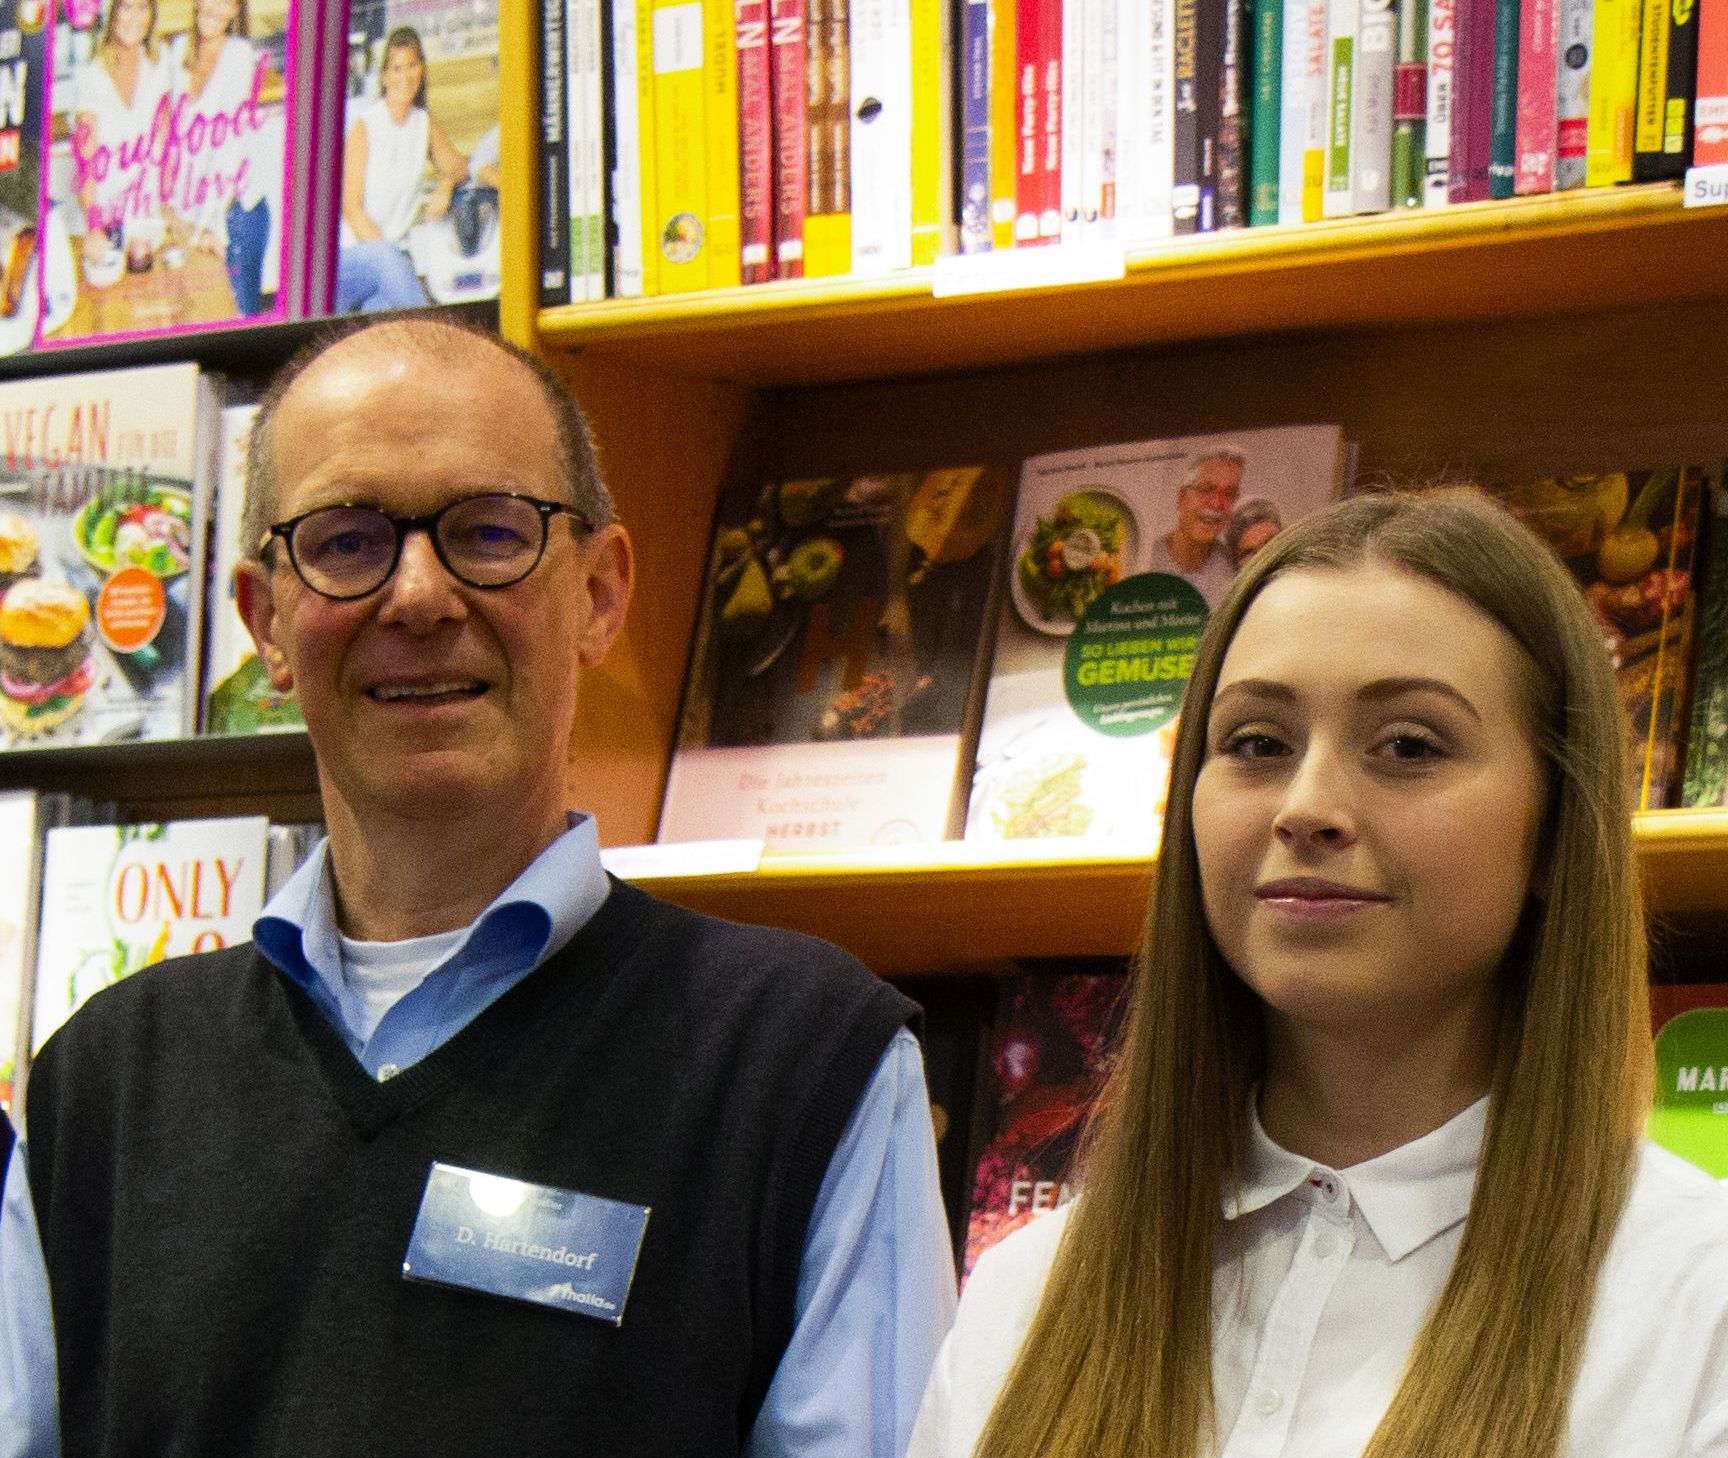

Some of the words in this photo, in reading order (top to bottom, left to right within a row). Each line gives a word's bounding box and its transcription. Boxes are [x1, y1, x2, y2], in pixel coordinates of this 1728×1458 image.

[184, 157, 251, 213] love
[743, 117, 764, 219] ANDERS
[779, 114, 800, 215] ANDERS
[3, 398, 112, 472] VEGAN
[765, 820, 843, 839] HERBST
[114, 856, 246, 924] ONLY
